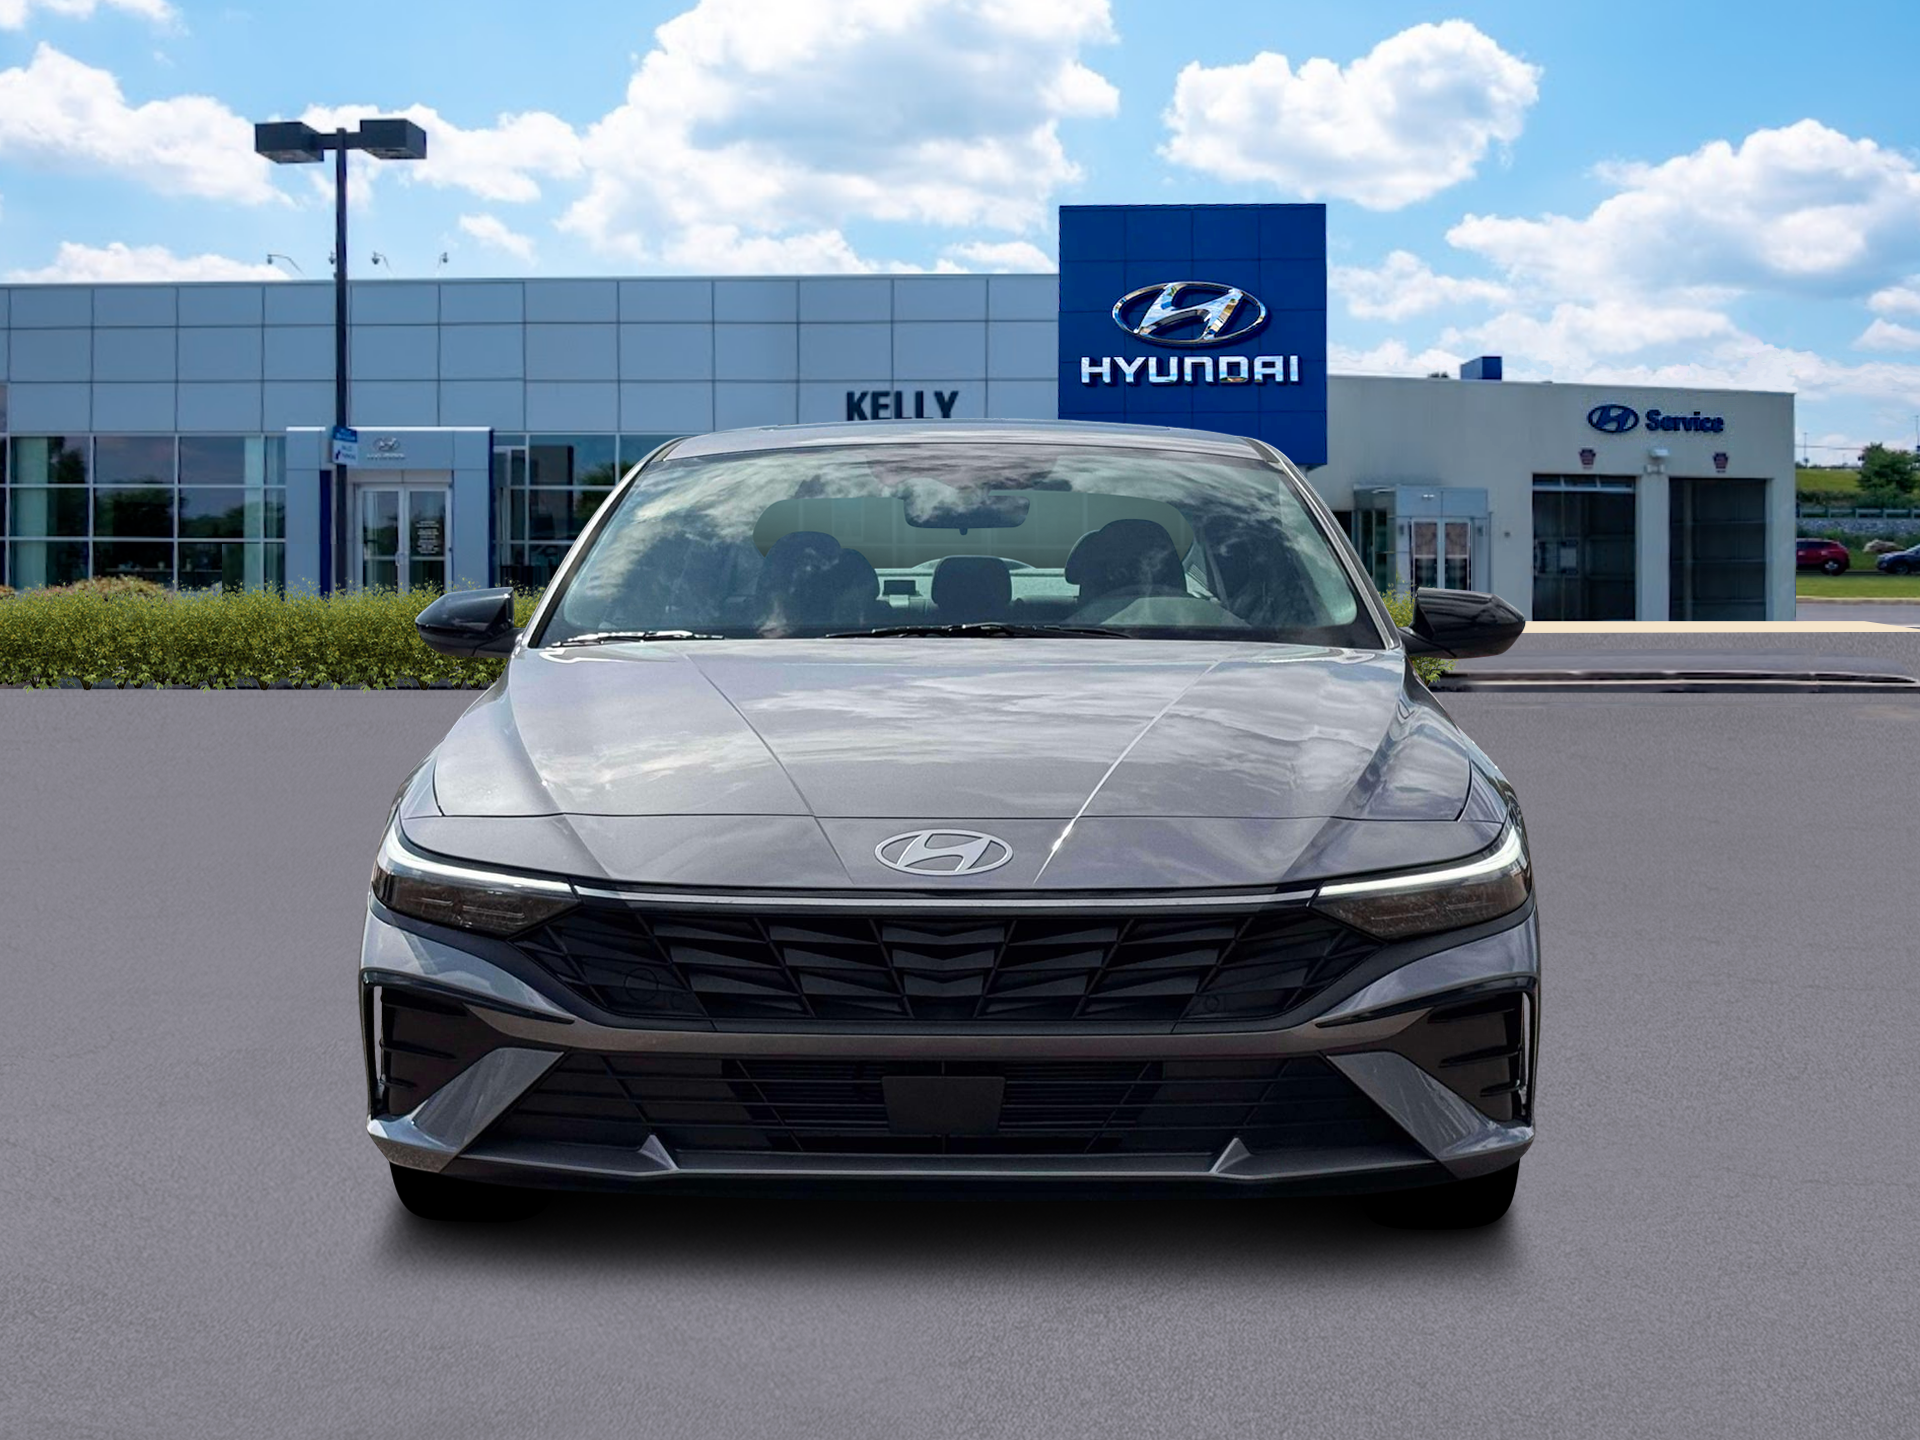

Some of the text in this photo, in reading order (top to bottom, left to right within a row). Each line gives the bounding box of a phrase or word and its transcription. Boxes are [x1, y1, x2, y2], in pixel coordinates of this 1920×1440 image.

[1080, 355, 1299, 384] HYUNDAI
[846, 390, 959, 421] KELLY
[1645, 409, 1724, 433] Service
